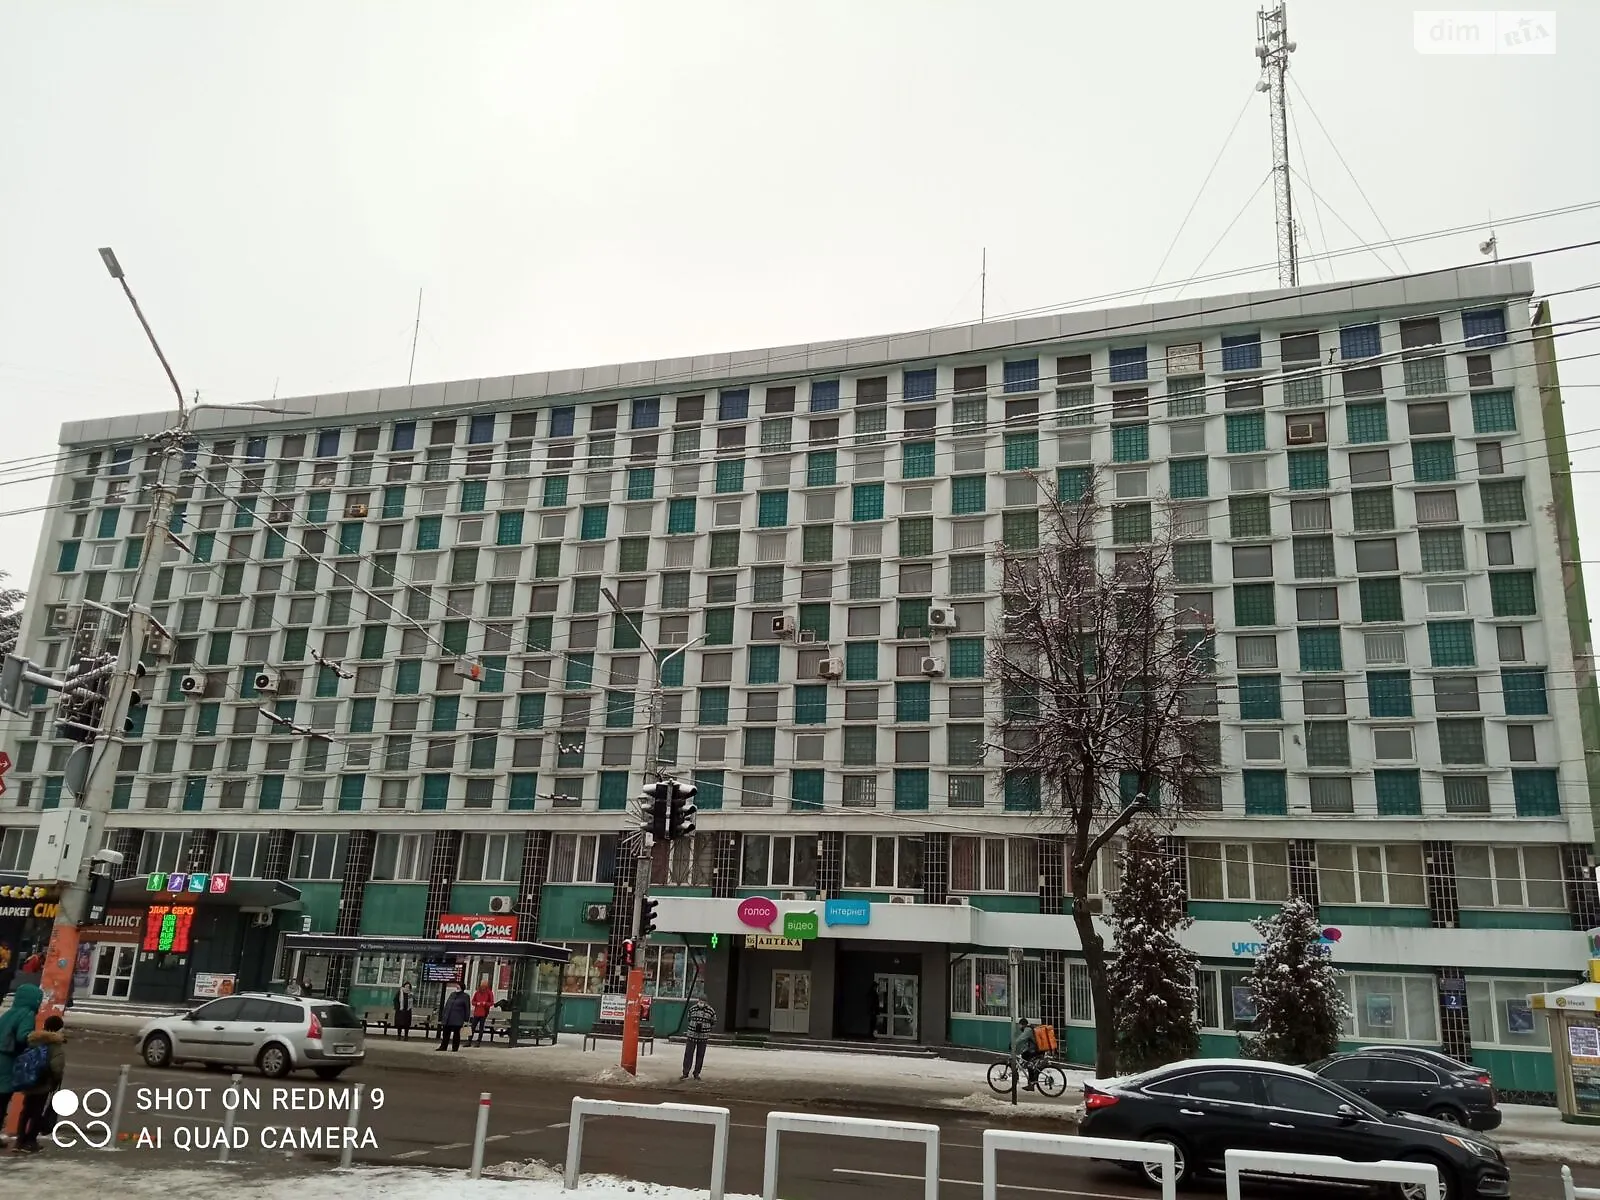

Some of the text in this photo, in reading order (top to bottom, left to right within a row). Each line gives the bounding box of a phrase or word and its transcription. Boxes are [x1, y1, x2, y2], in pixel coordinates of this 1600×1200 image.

[744, 907, 771, 917] голос
[830, 907, 867, 917] інтернет
[104, 915, 142, 927] ПІНІСТ
[787, 920, 814, 931] відео
[439, 923, 513, 936] МАМА ЗНАЄ
[758, 937, 801, 946] АПТЕКА
[1450, 995, 1457, 1005] 2
